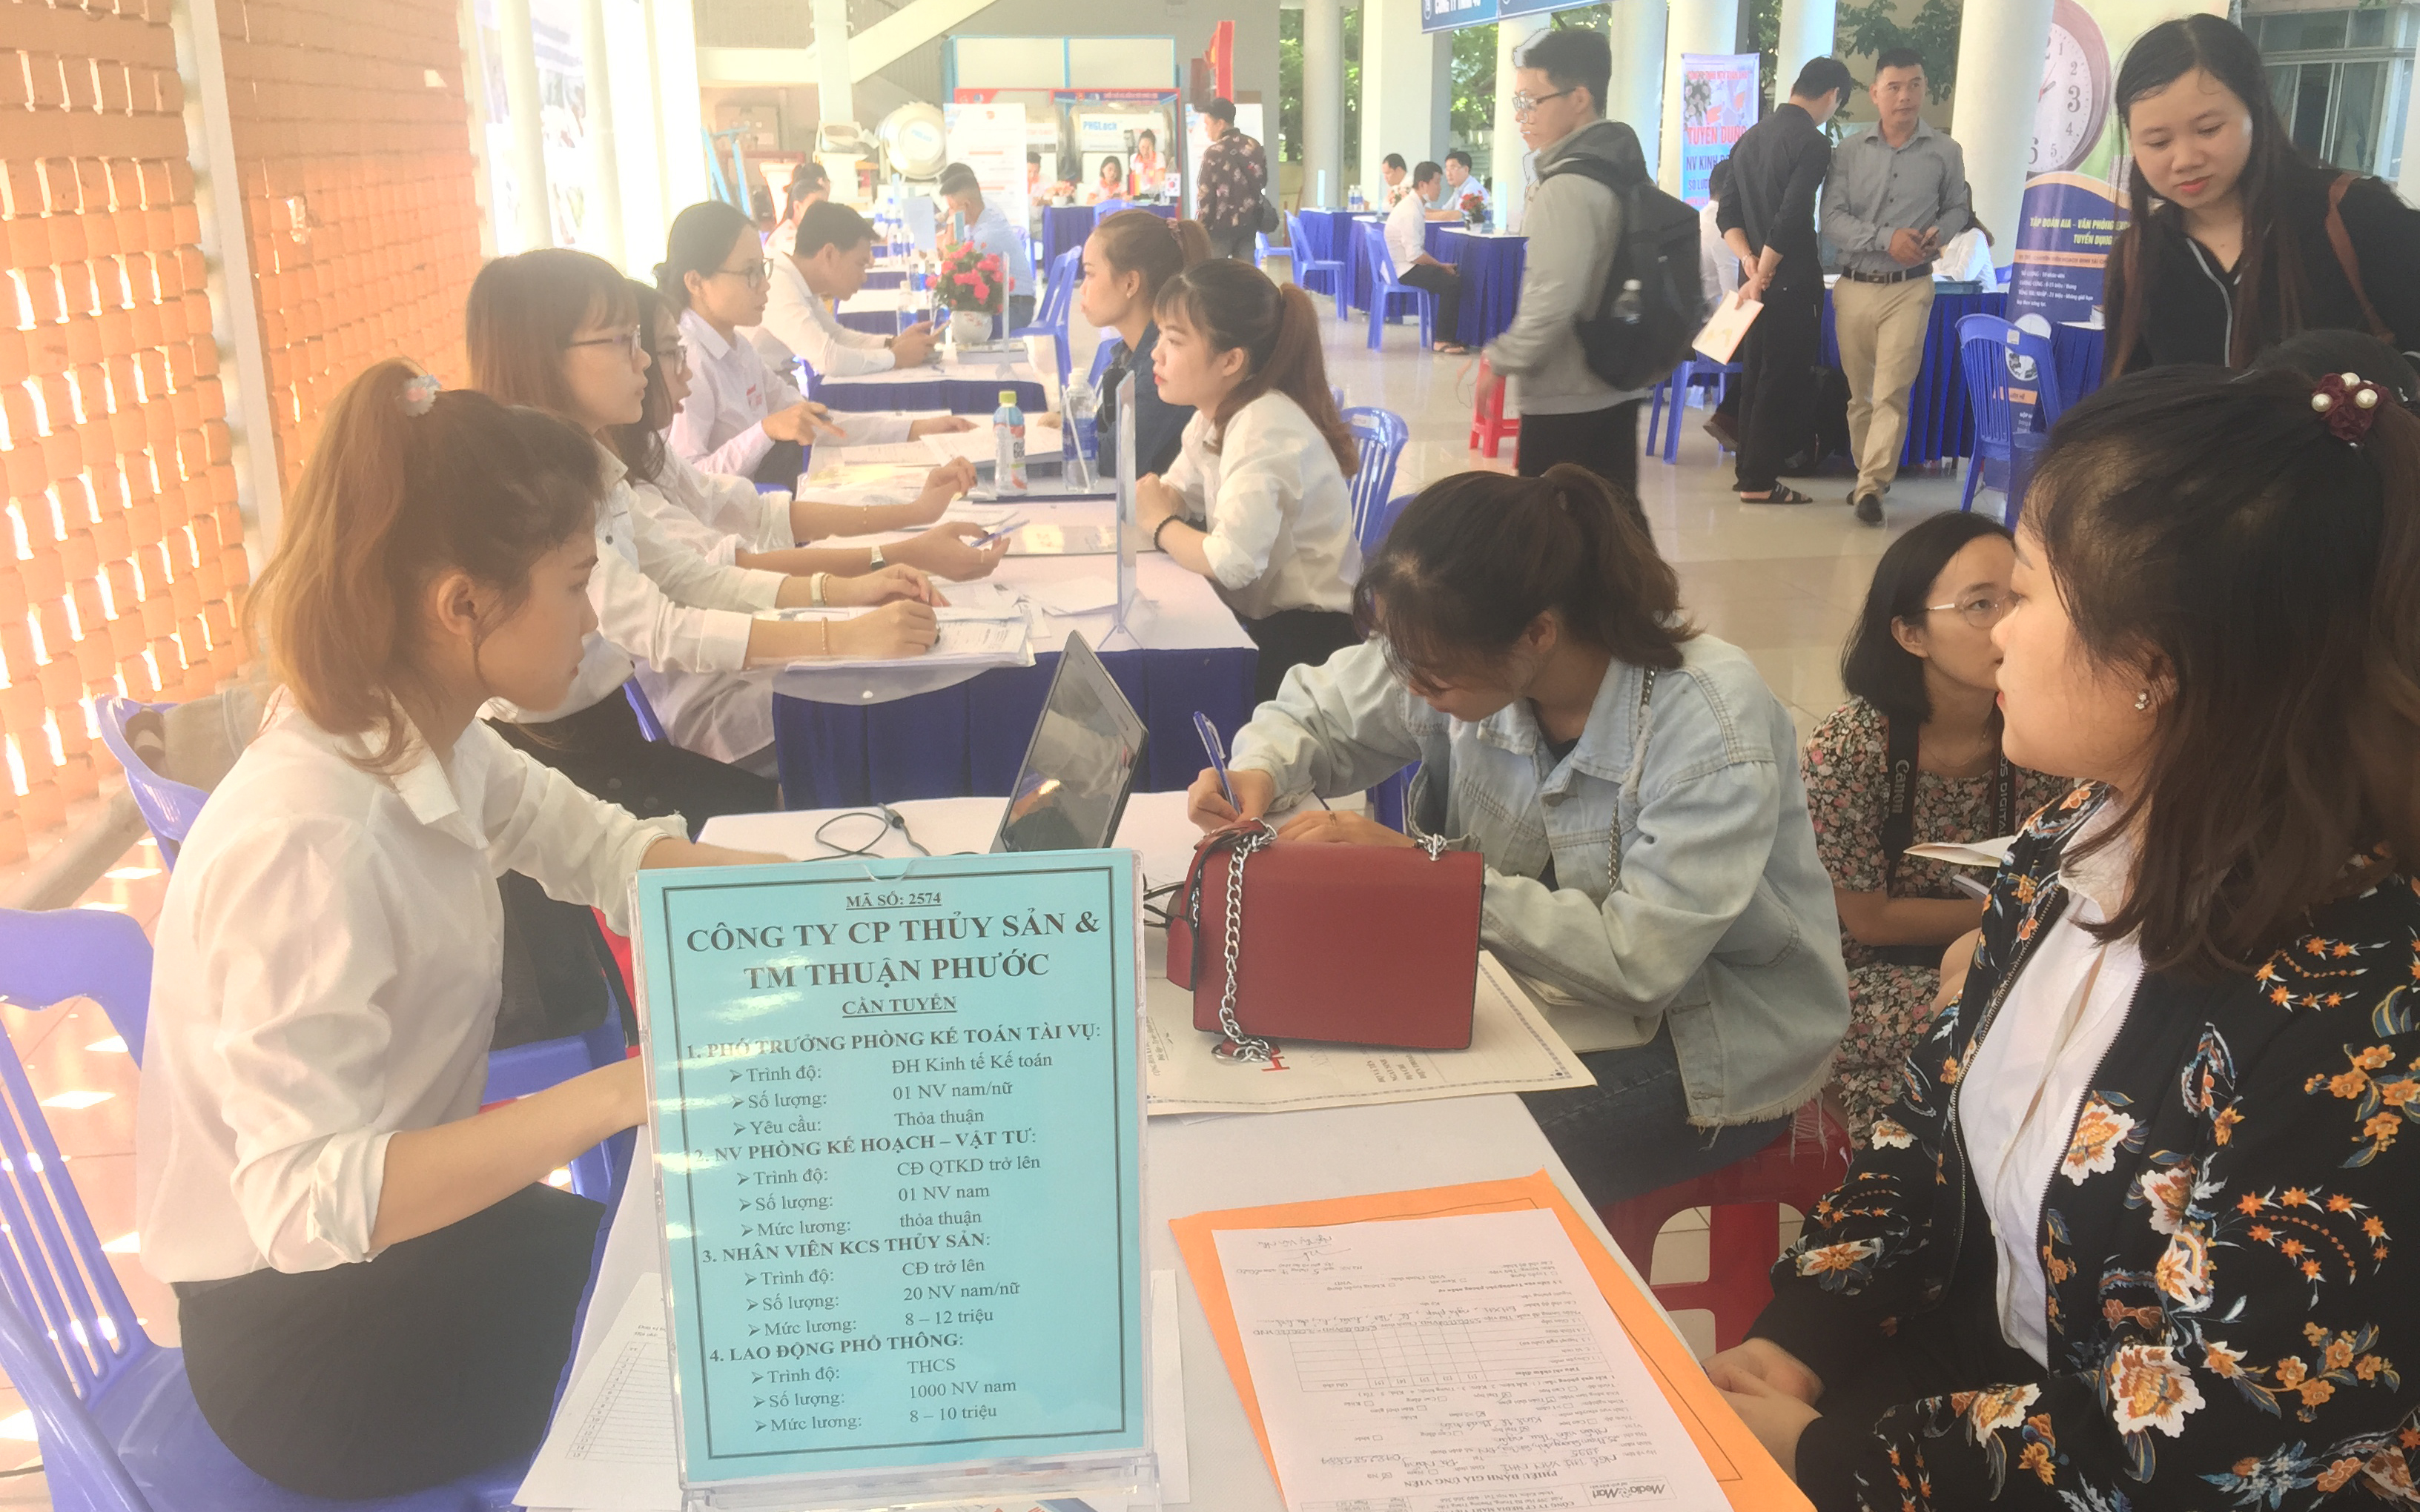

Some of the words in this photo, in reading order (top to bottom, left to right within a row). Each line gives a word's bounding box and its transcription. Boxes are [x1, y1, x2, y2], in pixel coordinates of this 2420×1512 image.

[2070, 62, 2077, 75] 2
[2067, 85, 2080, 113] 3
[2066, 122, 2073, 136] 4
[2051, 144, 2057, 157] 5
[846, 892, 873, 907] MÃ
[878, 890, 905, 906] SỐ:
[909, 892, 942, 904] 2574
[687, 921, 786, 952] CÔNG
[793, 924, 839, 946] TY
[848, 921, 891, 944] CP
[899, 910, 994, 941] THỦY
[1002, 907, 1067, 937] SẢN
[1075, 911, 1101, 933] &
[743, 966, 798, 989] TM
[804, 957, 922, 988] THUẬN
[932, 948, 1050, 980] PHƯỚC
[687, 1044, 701, 1058] 1.
[755, 1033, 845, 1054] TRƯỞNG
[851, 1029, 925, 1050] PHÒNG
[930, 1026, 959, 1045] KẾ
[964, 1024, 1022, 1044] TOÁN
[1027, 1021, 1062, 1041] TÀI
[1067, 1023, 1102, 1041] VỤ:
[746, 1065, 791, 1082] Trình
[796, 1064, 822, 1081] độ:
[892, 1059, 920, 1074] ĐH
[926, 1056, 965, 1072] Kinh
[971, 1051, 986, 1070] tế
[991, 1050, 1014, 1069] Kế
[1019, 1052, 1053, 1067] toán
[748, 1090, 770, 1109] Số
[775, 1093, 827, 1109] lượng:
[893, 1085, 910, 1100] 01
[918, 1084, 947, 1098] NV
[952, 1081, 1014, 1097] nam/nữ
[750, 1121, 783, 1135] Yêu
[788, 1115, 822, 1134] cầu:
[894, 1112, 936, 1127] Thỏa
[940, 1109, 985, 1125] thuận
[694, 1149, 710, 1162] 2.
[715, 1147, 742, 1161] NV
[749, 1140, 821, 1159] PHÒNG
[827, 1135, 855, 1154] KẾ
[861, 1135, 936, 1154] HOẠCH
[955, 1130, 998, 1149] VẬT
[1002, 1127, 1037, 1144] TƯ:
[753, 1171, 798, 1186] Trình
[802, 1167, 829, 1184] độ:
[897, 1161, 925, 1176] CĐ
[930, 1158, 985, 1177] QTKD
[989, 1157, 1012, 1171] trở
[1017, 1156, 1041, 1170] lên
[756, 1193, 776, 1211] Số
[781, 1196, 834, 1210] lượng:
[899, 1187, 916, 1201] 01
[923, 1185, 951, 1200] NV
[956, 1186, 990, 1198] nam
[758, 1223, 795, 1236] Mức
[800, 1220, 851, 1235] lương:
[900, 1213, 933, 1227] thỏa
[938, 1210, 982, 1226] thuận
[703, 1250, 717, 1263] 3.
[723, 1242, 779, 1261] NHÂN
[785, 1239, 834, 1258] VIÊN
[840, 1239, 880, 1255] KCS
[885, 1232, 941, 1252] THỦY
[946, 1230, 991, 1248] SẢN:
[761, 1268, 804, 1285] Trình
[809, 1268, 834, 1284] độ:
[902, 1261, 928, 1276] CĐ
[934, 1260, 957, 1273] trở
[962, 1259, 985, 1273] lên
[762, 1293, 784, 1311] Số
[788, 1295, 839, 1310] lượng:
[904, 1287, 922, 1301] 20
[928, 1284, 956, 1299] NV
[960, 1281, 1020, 1298] nam/nữ
[764, 1322, 801, 1336] Mức
[806, 1319, 857, 1333] lương:
[905, 1312, 914, 1326] 8
[936, 1310, 953, 1324] 12
[958, 1308, 994, 1324] triệu
[710, 1349, 724, 1362] 4.
[730, 1346, 771, 1361] LAO
[776, 1342, 835, 1360] ĐỘNG
[840, 1334, 882, 1353] PHỔ
[887, 1330, 963, 1350] THÔNG:
[767, 1368, 810, 1383] Trình
[815, 1366, 840, 1382] độ:
[907, 1358, 956, 1374] THCS
[769, 1390, 789, 1407] Số
[794, 1393, 844, 1407] lượng:
[910, 1383, 946, 1399] 1000
[951, 1381, 979, 1396] NV
[984, 1382, 1017, 1393] nam
[771, 1419, 807, 1432] Mức
[813, 1416, 862, 1430] lương:
[910, 1410, 919, 1423] 8
[940, 1407, 957, 1421] 10
[962, 1405, 997, 1420] triệu
[1630, 1484, 1665, 1495] Media
